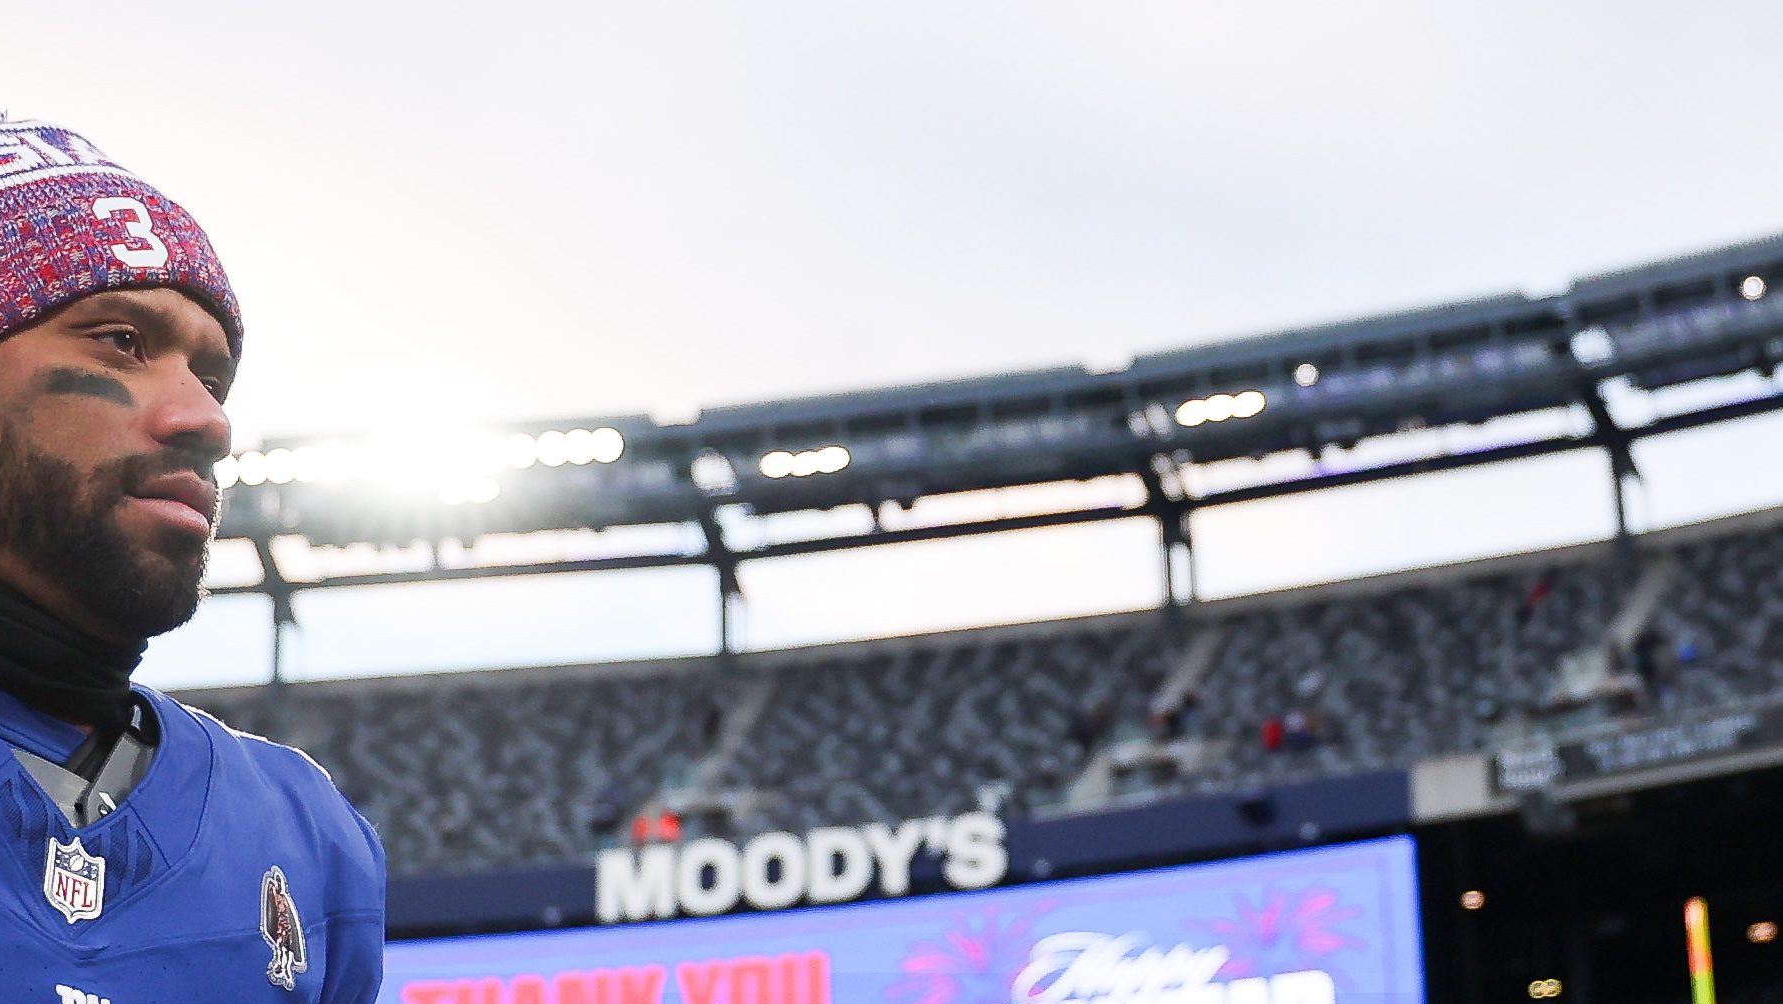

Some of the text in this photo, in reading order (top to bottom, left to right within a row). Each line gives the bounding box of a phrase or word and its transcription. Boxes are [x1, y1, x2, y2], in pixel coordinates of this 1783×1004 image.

[91, 196, 170, 268] 3
[56, 871, 94, 908] NFL
[595, 811, 1008, 924] MOODY'S
